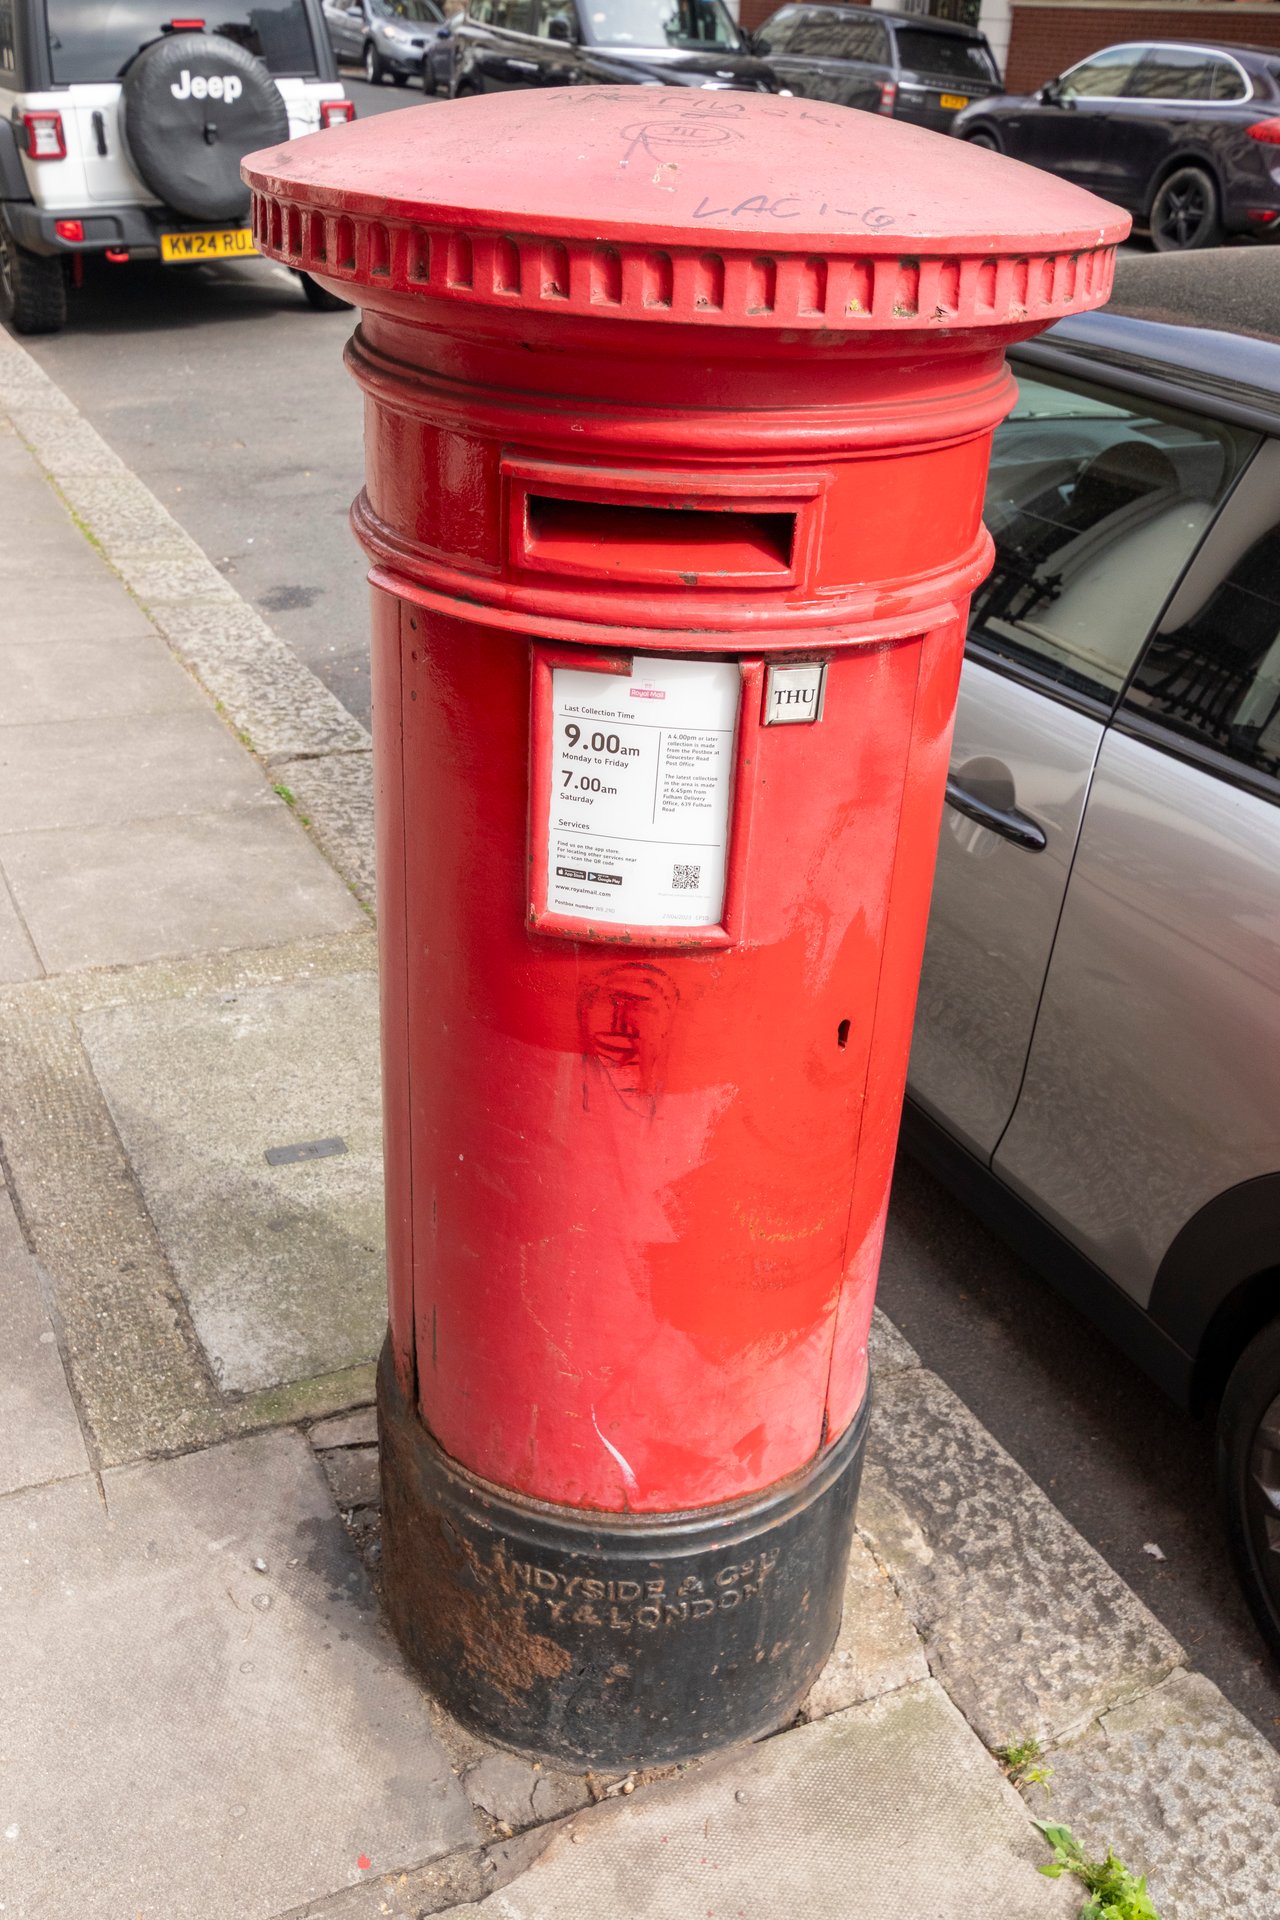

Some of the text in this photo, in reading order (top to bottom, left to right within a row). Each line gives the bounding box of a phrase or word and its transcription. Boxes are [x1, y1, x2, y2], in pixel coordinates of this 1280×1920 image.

[170, 70, 242, 104] Jeep
[170, 233, 253, 255] KW24 RU
[774, 688, 816, 704] THU
[564, 704, 635, 719] Last Collection Time
[564, 723, 640, 757] 9.00am
[562, 752, 592, 764] Monday
[604, 758, 629, 769] Friday
[561, 769, 617, 795] 7.00am
[560, 792, 594, 805] Saturday
[558, 818, 590, 830] Services
[566, 848, 586, 856] locating
[555, 884, 611, 897] www.royalmail.com
[554, 899, 574, 907] Postbox
[677, 1575, 704, 1597] &
[571, 1604, 602, 1626] &
[609, 1580, 763, 1630] LONDON
